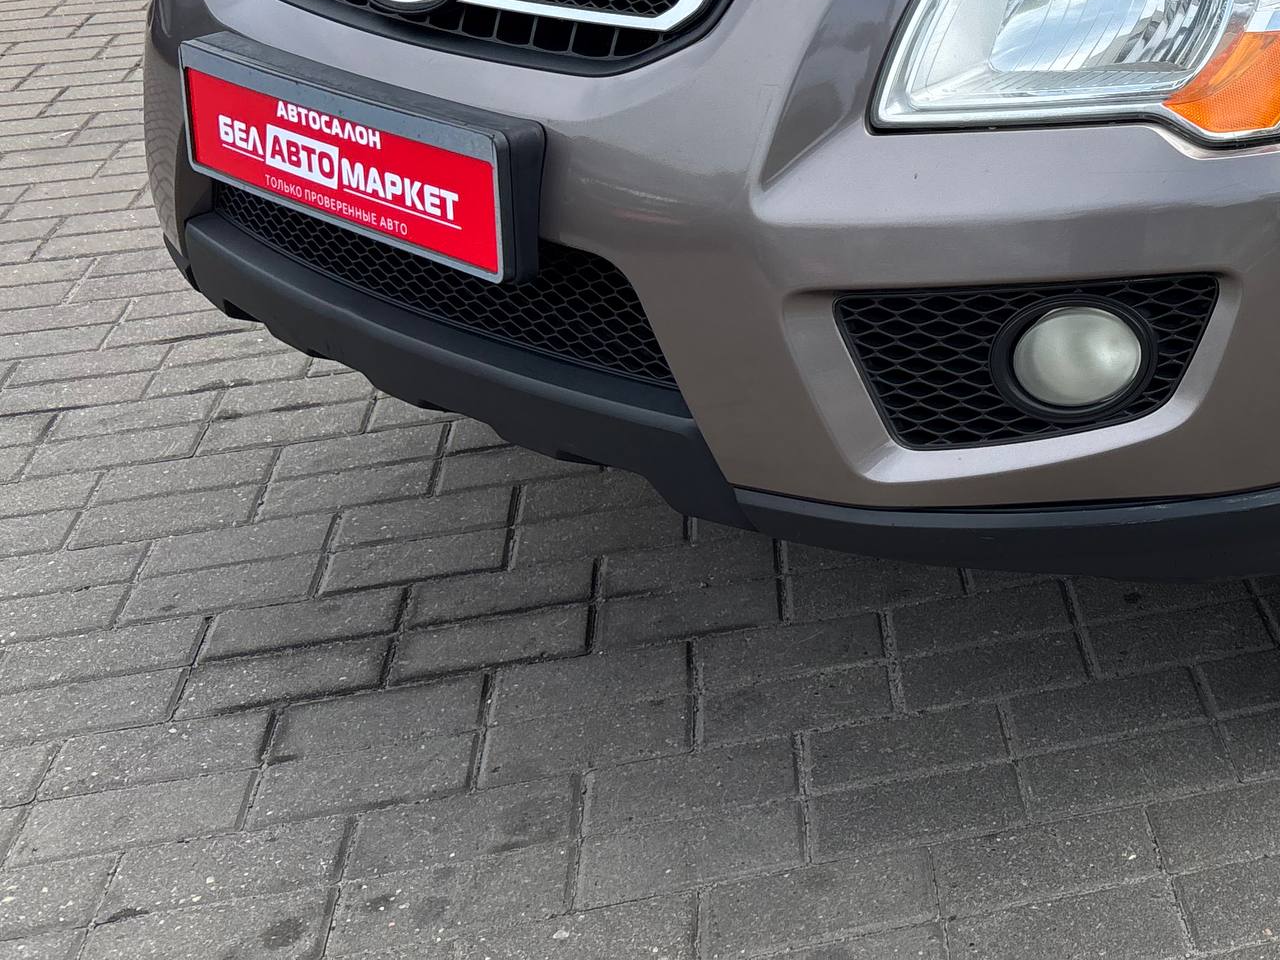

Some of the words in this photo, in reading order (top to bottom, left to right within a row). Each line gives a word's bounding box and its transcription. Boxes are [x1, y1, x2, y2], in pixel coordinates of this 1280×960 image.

[276, 100, 382, 150] АВТОСАЛОН
[264, 173, 303, 200] ТОЛЬКО
[304, 183, 378, 227] ПРОВЕРЕННЫЕ
[378, 215, 409, 236] АВТО
